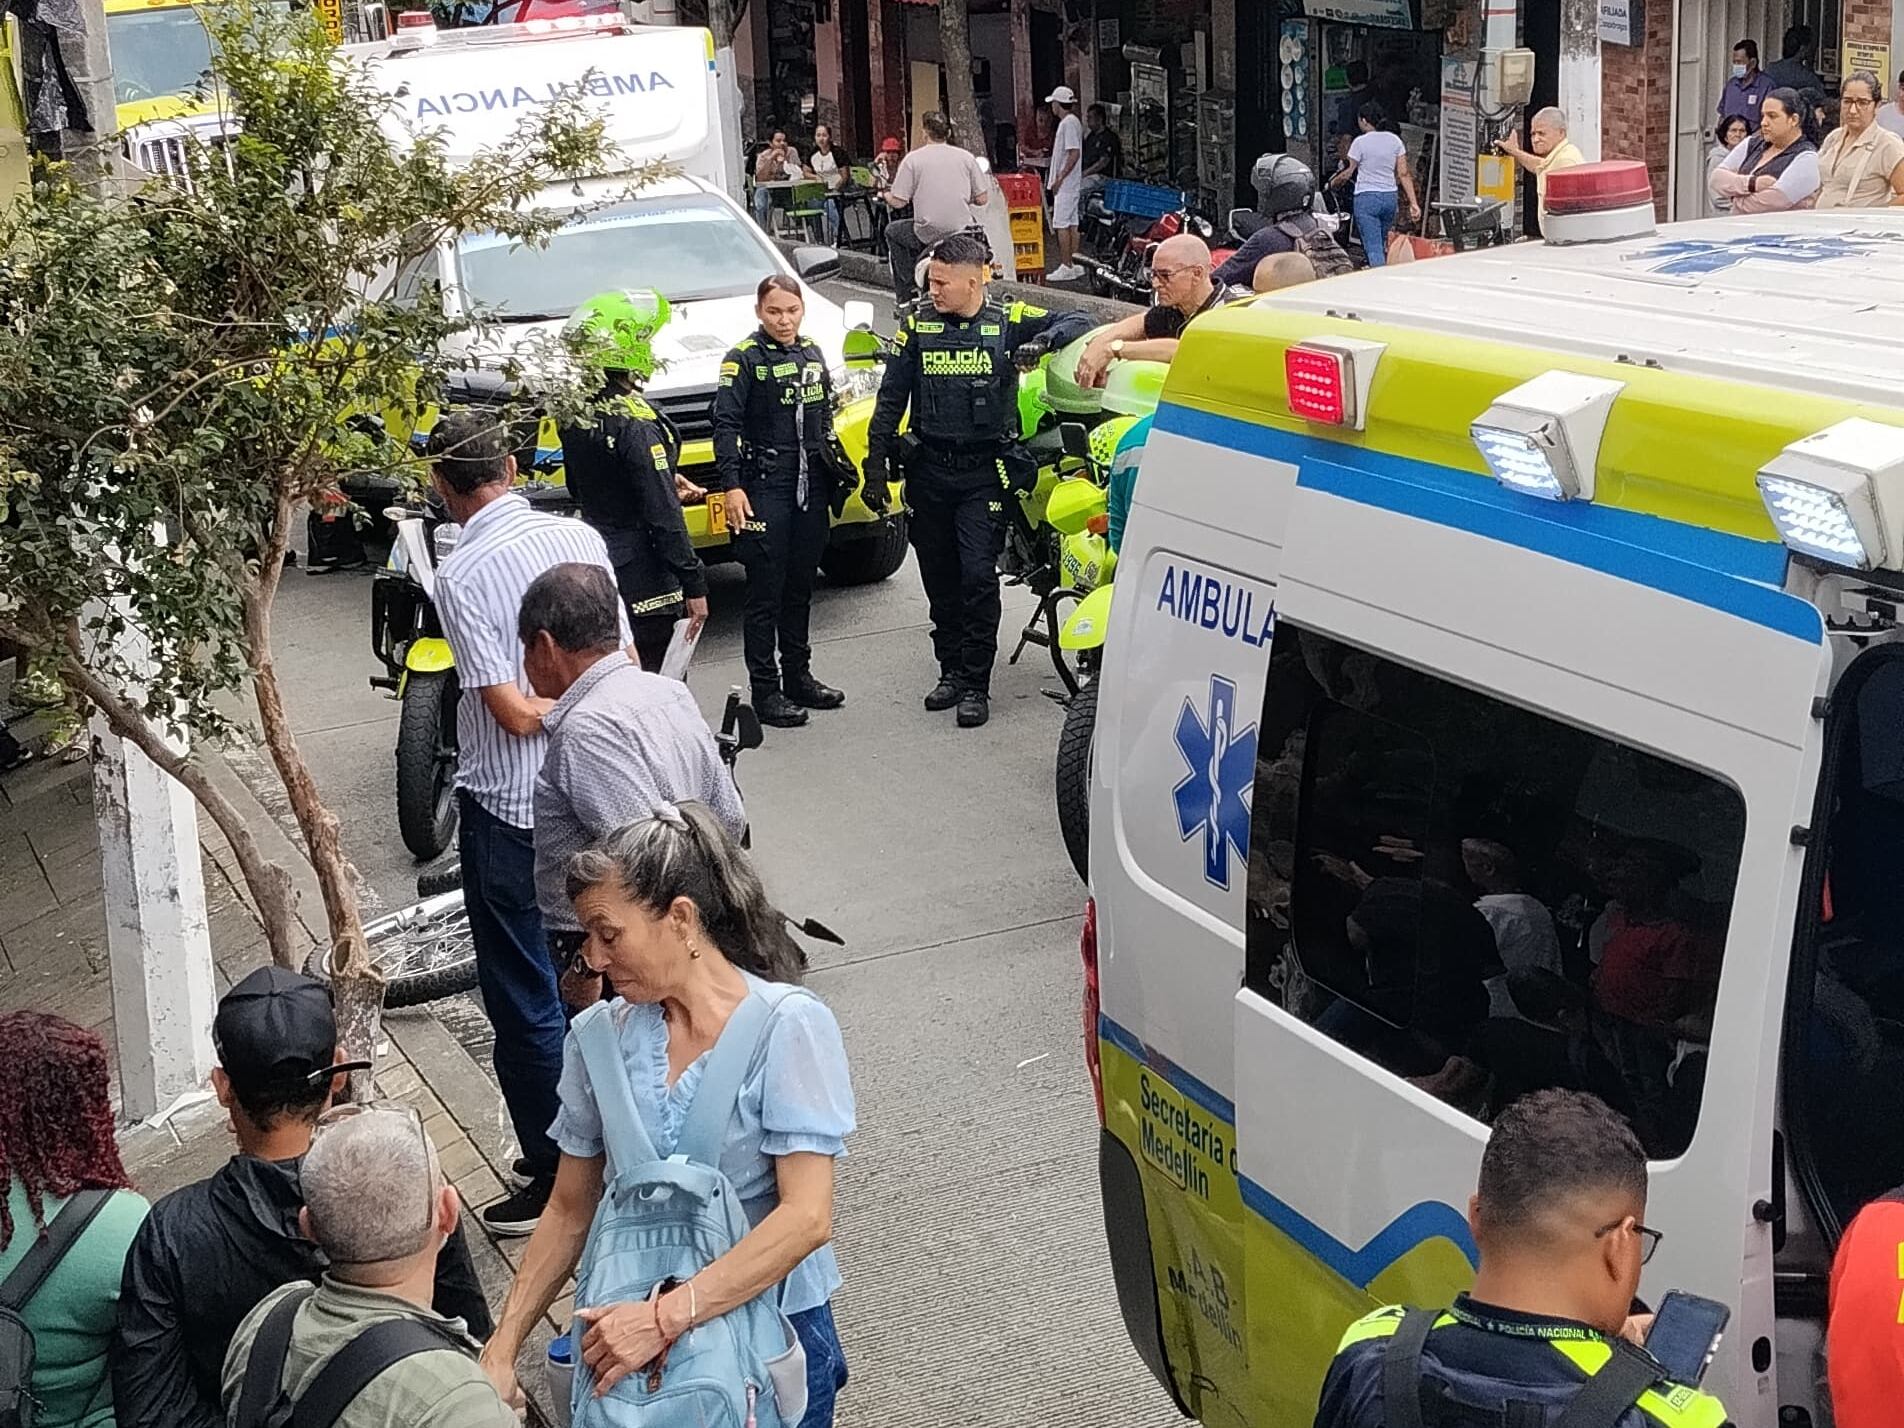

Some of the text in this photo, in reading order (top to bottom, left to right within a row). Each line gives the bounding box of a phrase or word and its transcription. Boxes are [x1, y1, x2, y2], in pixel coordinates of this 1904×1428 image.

[922, 346, 992, 365] POLICÍA
[785, 382, 823, 399] PLICÍA
[1140, 1073, 1224, 1168] Secretaría
[1537, 1326, 1586, 1340] NACIONAL
